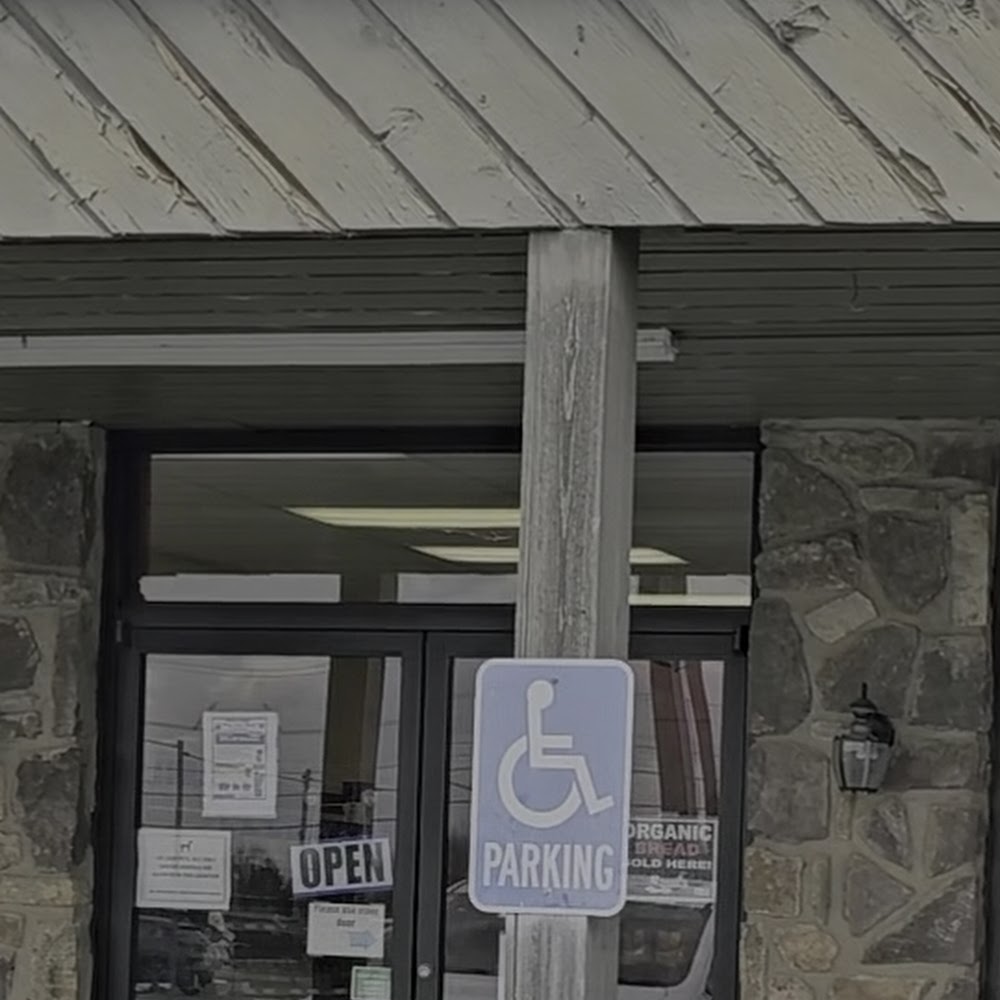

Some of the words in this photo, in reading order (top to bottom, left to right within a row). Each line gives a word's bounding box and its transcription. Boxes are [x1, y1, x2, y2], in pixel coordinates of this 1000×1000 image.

[299, 842, 385, 889] OPEN
[628, 858, 662, 869] OLD
[634, 841, 701, 858] BREAD
[482, 841, 615, 892] PARKING
